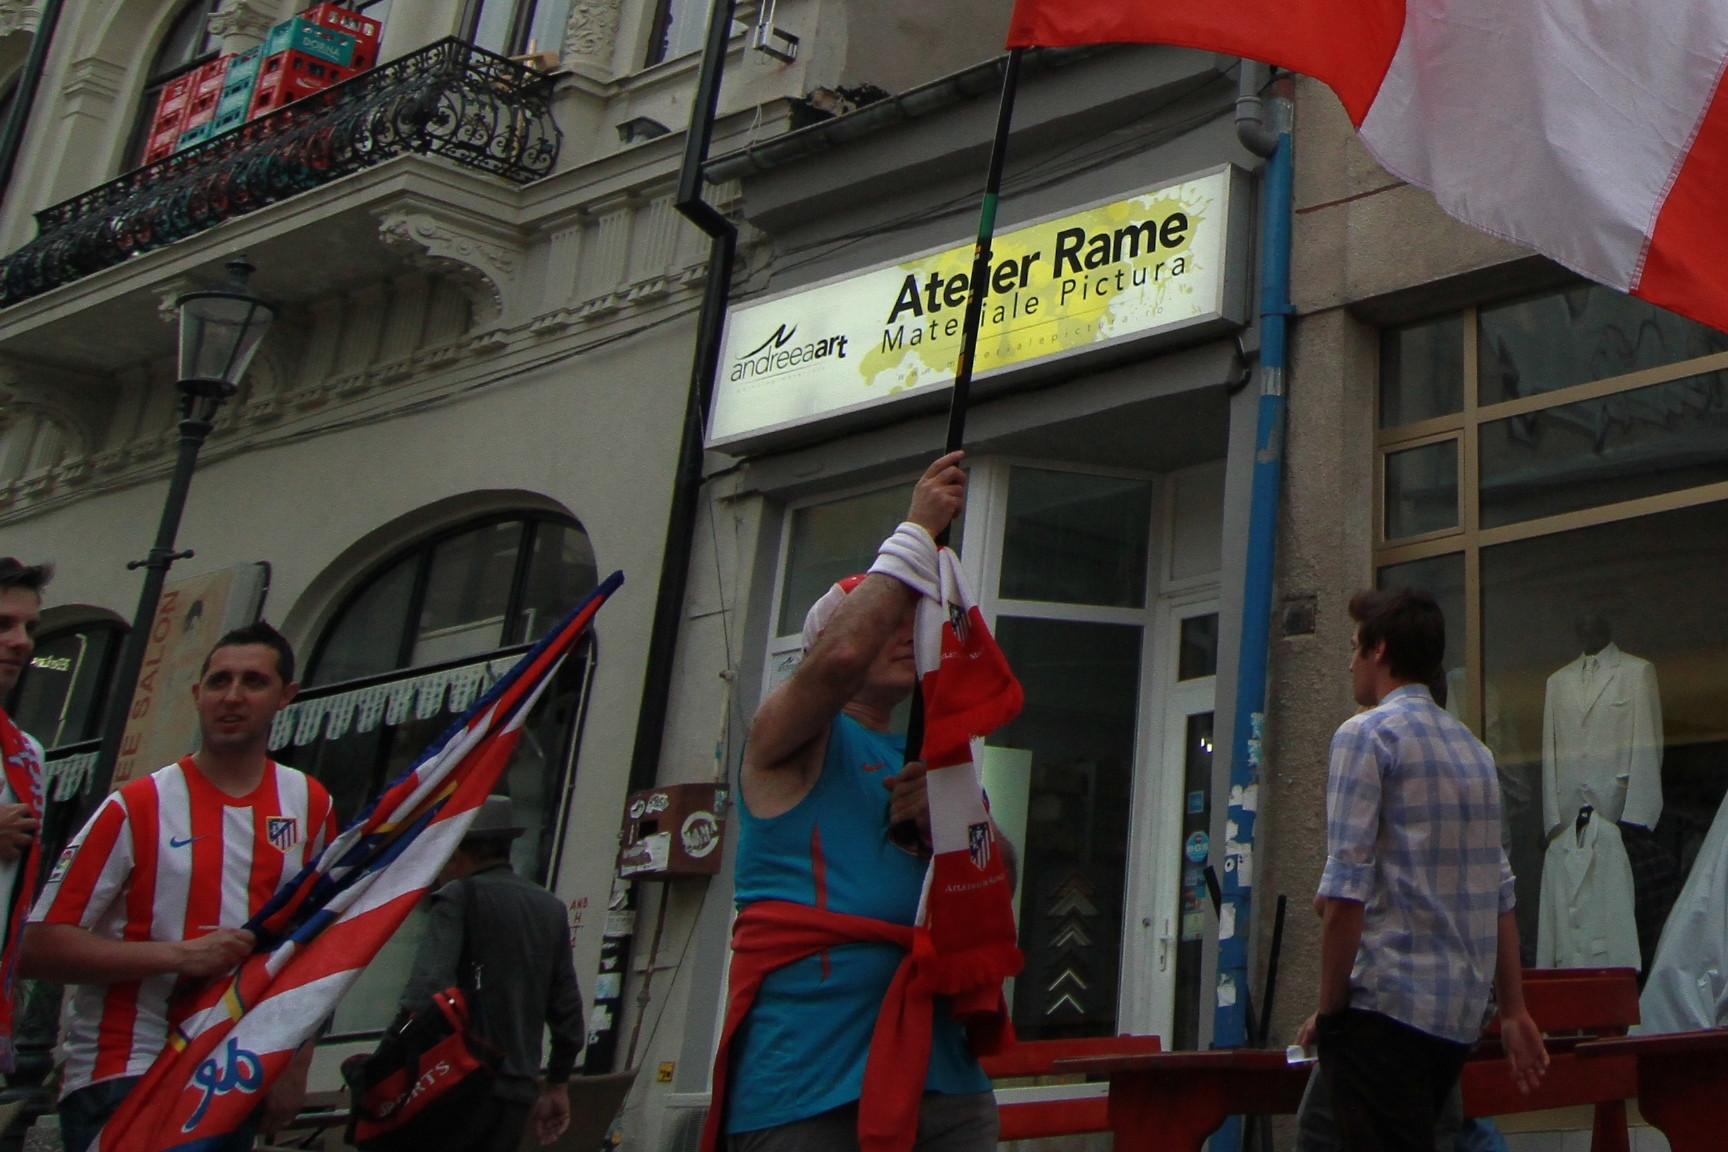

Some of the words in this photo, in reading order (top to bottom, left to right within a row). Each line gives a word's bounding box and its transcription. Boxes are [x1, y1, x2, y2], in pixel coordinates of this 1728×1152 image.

[302, 37, 341, 57] DORNA
[881, 292, 1039, 354] Mateiale
[1060, 257, 1185, 306] Pictura
[887, 250, 1041, 325] Ateier
[1053, 212, 1188, 279] Rame
[731, 335, 849, 382] andreeaart
[131, 590, 181, 721] SALON
